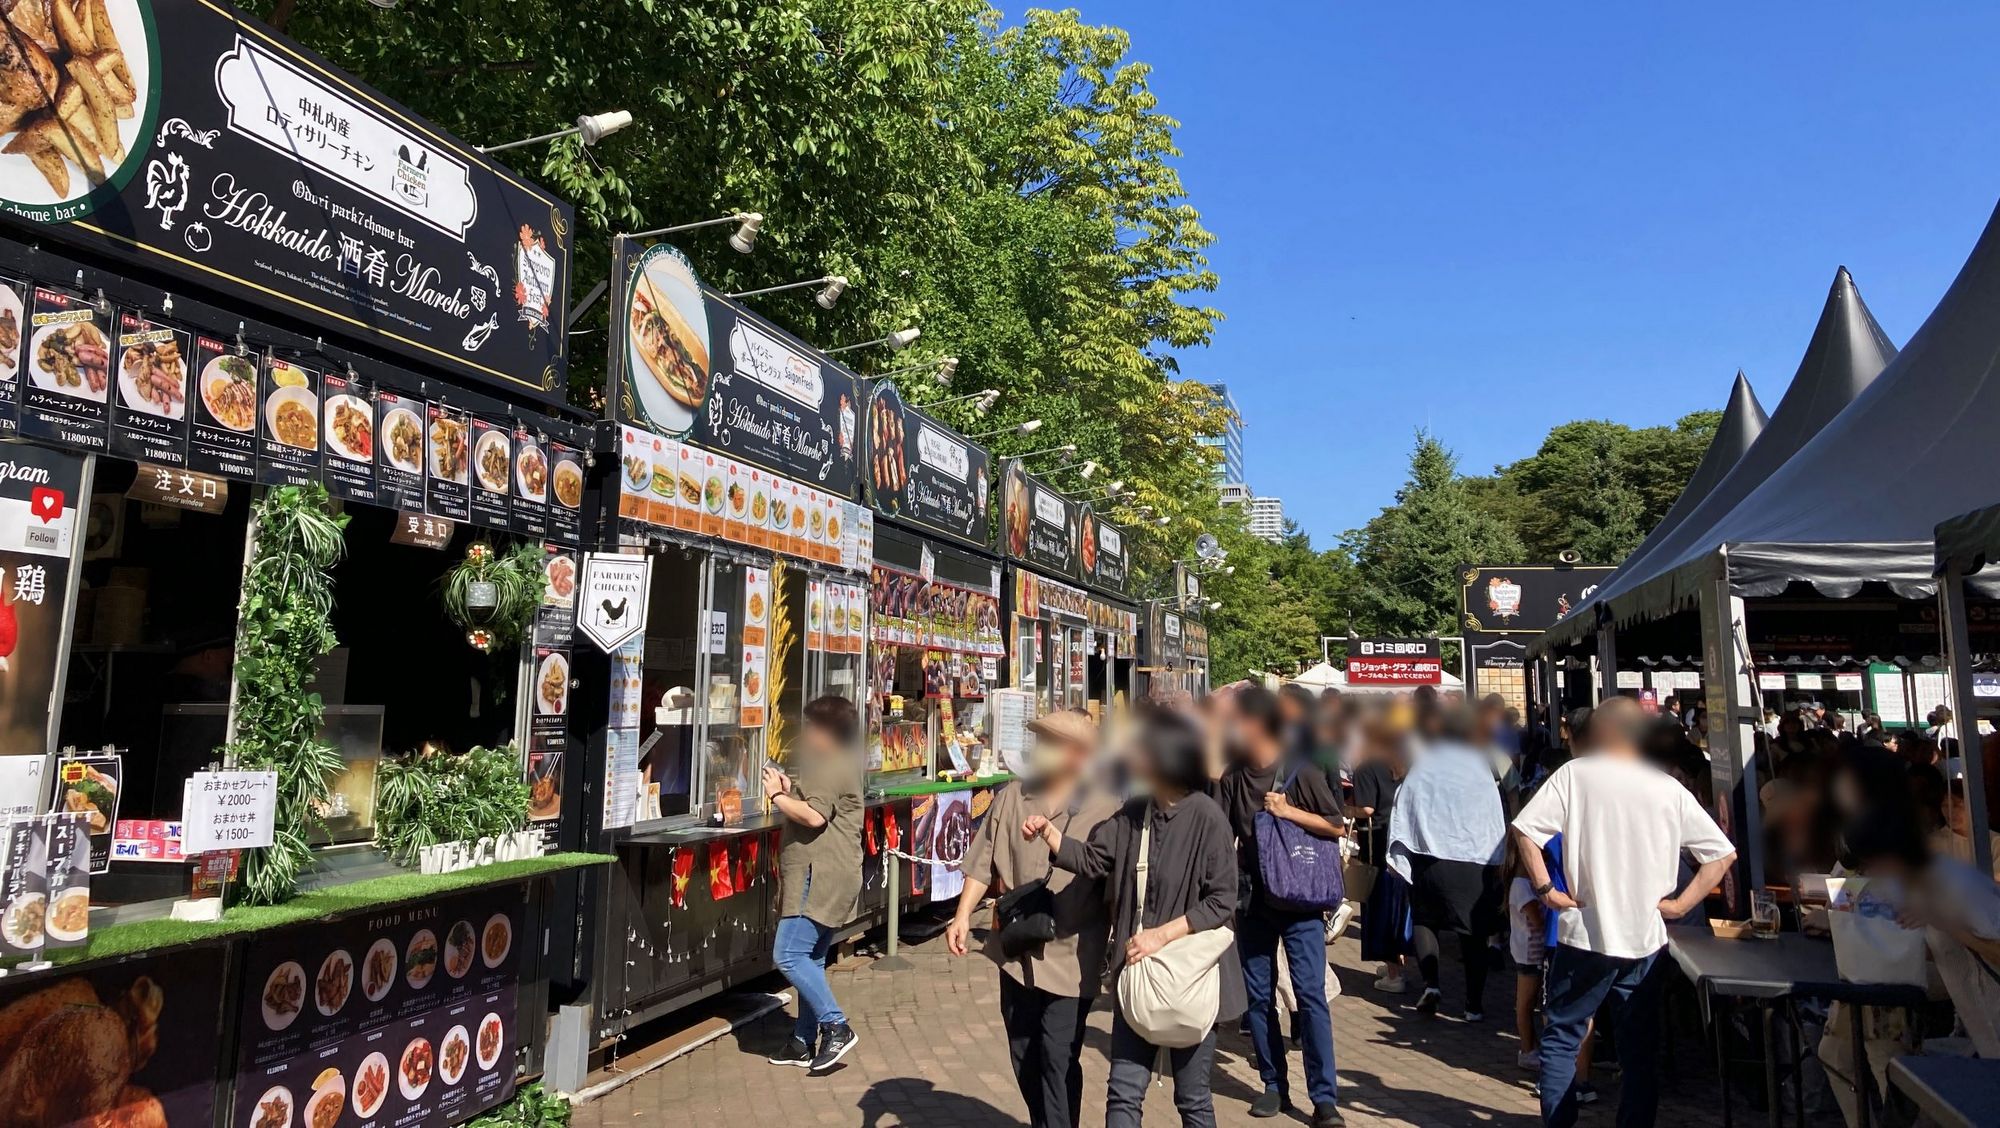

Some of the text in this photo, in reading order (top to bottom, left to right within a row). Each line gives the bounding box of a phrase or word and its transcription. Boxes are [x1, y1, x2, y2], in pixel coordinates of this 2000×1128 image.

[298, 97, 351, 140] 中札内産
[266, 105, 376, 173] ロティサリーチキン
[397, 169, 427, 190] Chicken
[53, 206, 77, 220] bar
[292, 179, 329, 211] Odori
[397, 228, 415, 250] bar
[203, 173, 471, 320] Hokkaido 酒肴 Marche
[750, 341, 774, 360] バインミー
[128, 415, 172, 432] チキンプレート
[726, 398, 772, 440] Hokkaido
[790, 425, 823, 462] Marche
[60, 431, 104, 447] ¥1800YEN
[195, 429, 251, 448] チキンオーバーライス
[144, 447, 183, 462] ¥1800YEN
[219, 462, 254, 476] ¥1000YEN
[154, 468, 217, 500] 注文口
[407, 516, 447, 538] 受渡口
[29, 532, 56, 545] Follow
[592, 571, 640, 581] FARMER'S
[594, 582, 637, 593] CHICKEN
[1374, 643, 1427, 654] ゴミ回収口
[1361, 663, 1439, 672] ジョッキ・グラス回収口
[203, 779, 268, 792] おまかせプレート
[212, 812, 256, 825] おまかせ丼
[419, 829, 545, 875] WELCOME
[50, 825, 68, 918] スープカレー
[368, 907, 440, 932] FOOD MENU
